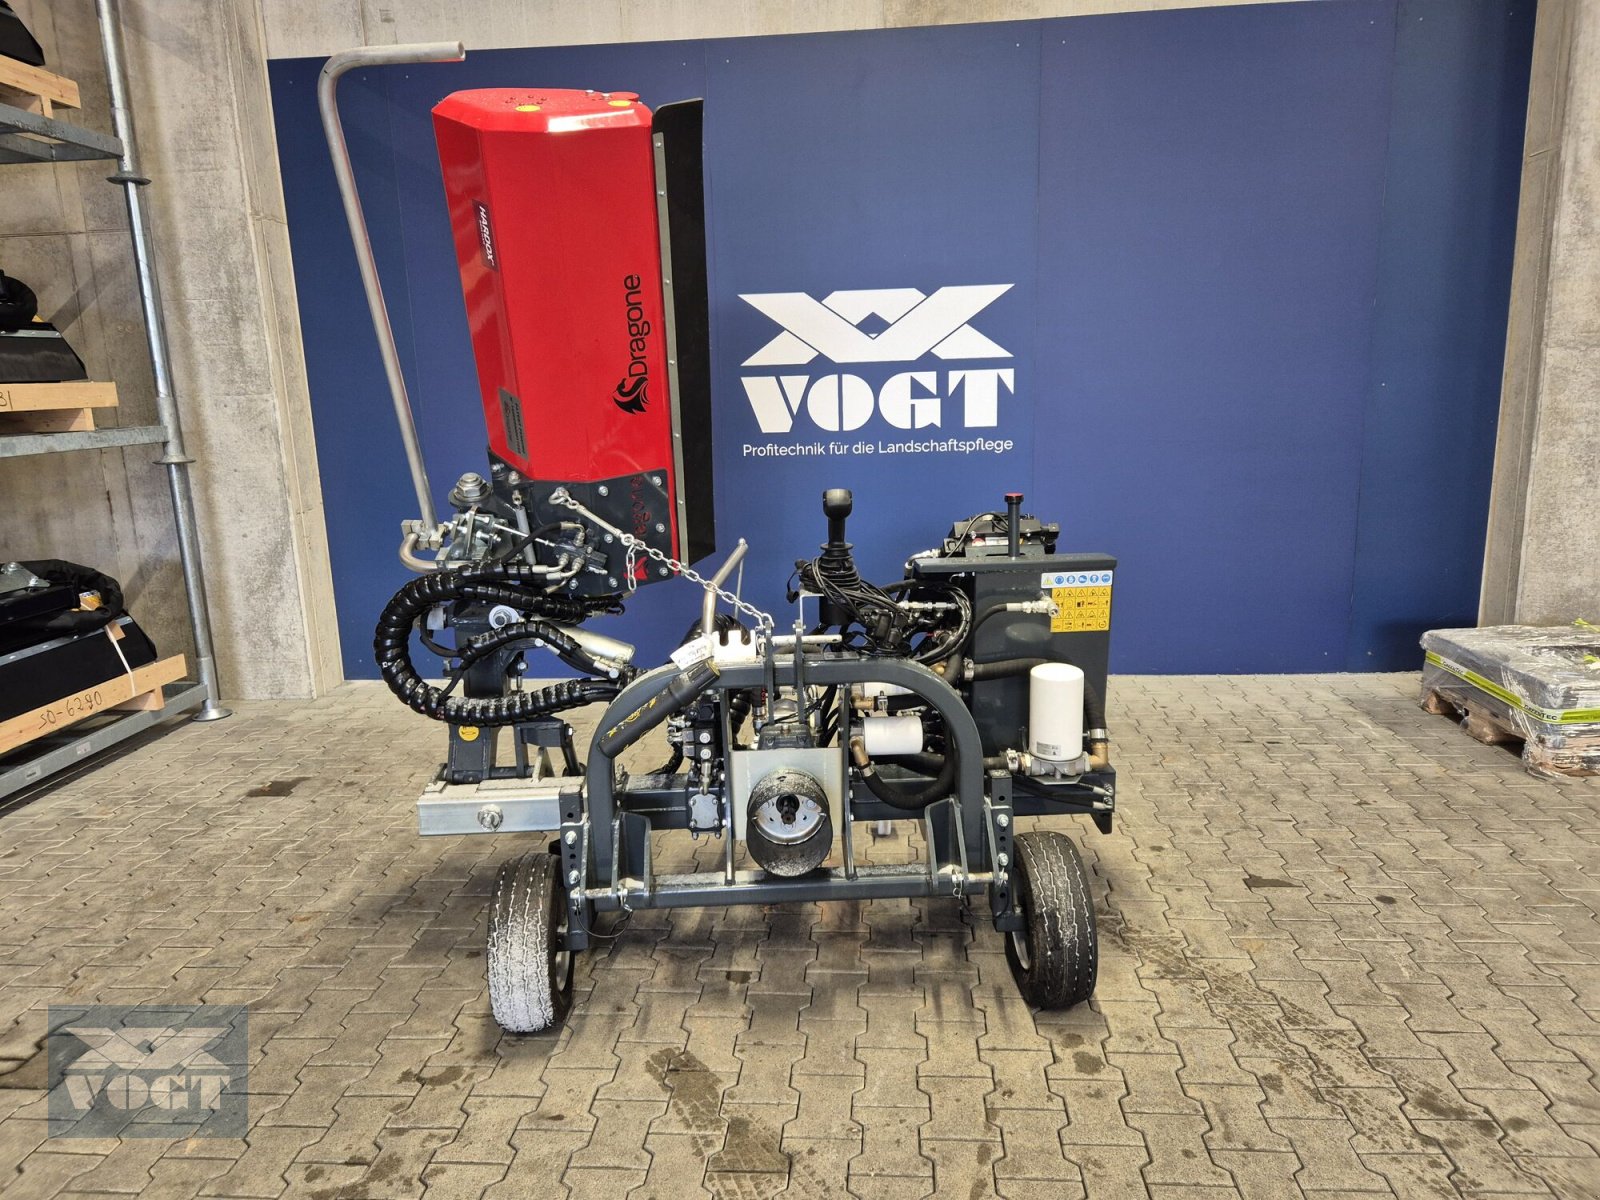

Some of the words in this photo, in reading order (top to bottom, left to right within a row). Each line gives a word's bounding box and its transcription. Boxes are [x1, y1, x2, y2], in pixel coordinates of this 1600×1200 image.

[478, 206, 494, 261] HARDOX
[624, 274, 650, 377] Dragone
[740, 368, 1014, 433] VOGT
[743, 441, 825, 457] Profitechnik
[829, 441, 848, 455] für
[851, 441, 874, 454] die
[878, 437, 1014, 455] Landschaftspflege
